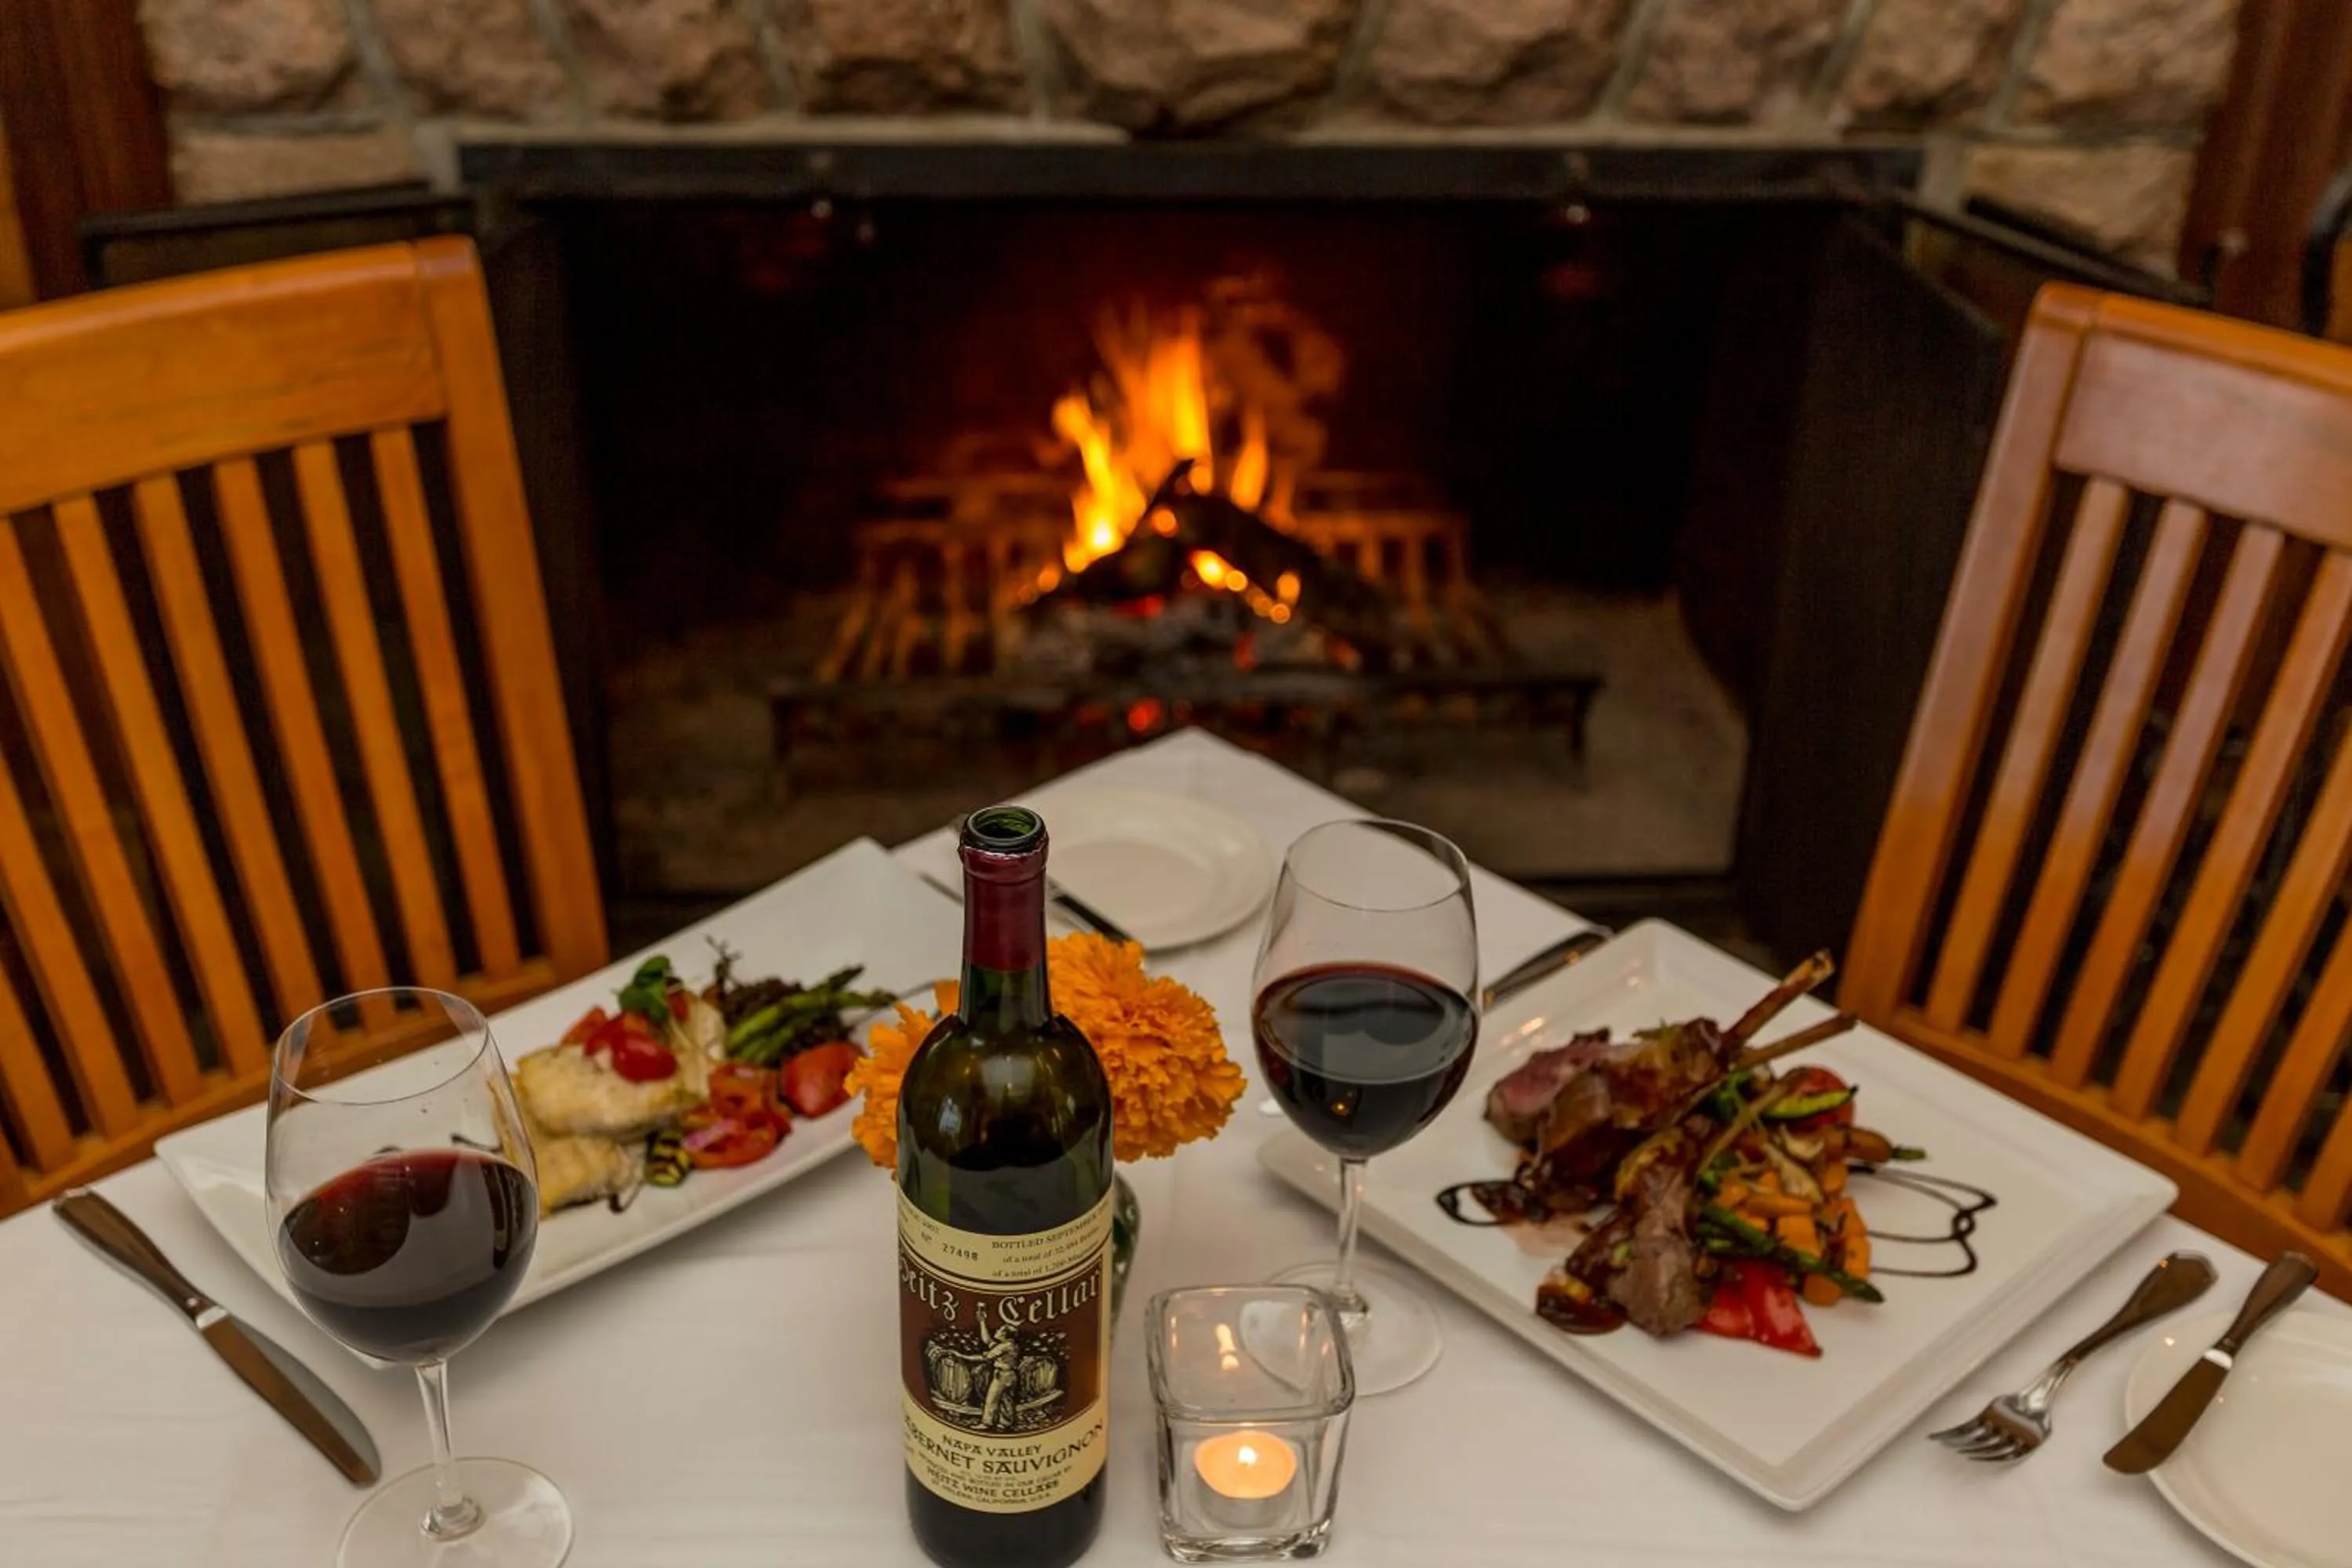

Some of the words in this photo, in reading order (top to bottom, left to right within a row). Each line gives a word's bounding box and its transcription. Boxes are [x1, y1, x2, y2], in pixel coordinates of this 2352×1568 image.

[942, 1243, 978, 1261] 27498
[992, 1238, 1044, 1249] BOTTLED
[942, 1434, 982, 1456] NAPA
[985, 1443, 1042, 1457] VALLEY
[983, 1417, 1103, 1475] SAUVIGNON
[961, 1483, 998, 1498] WINE
